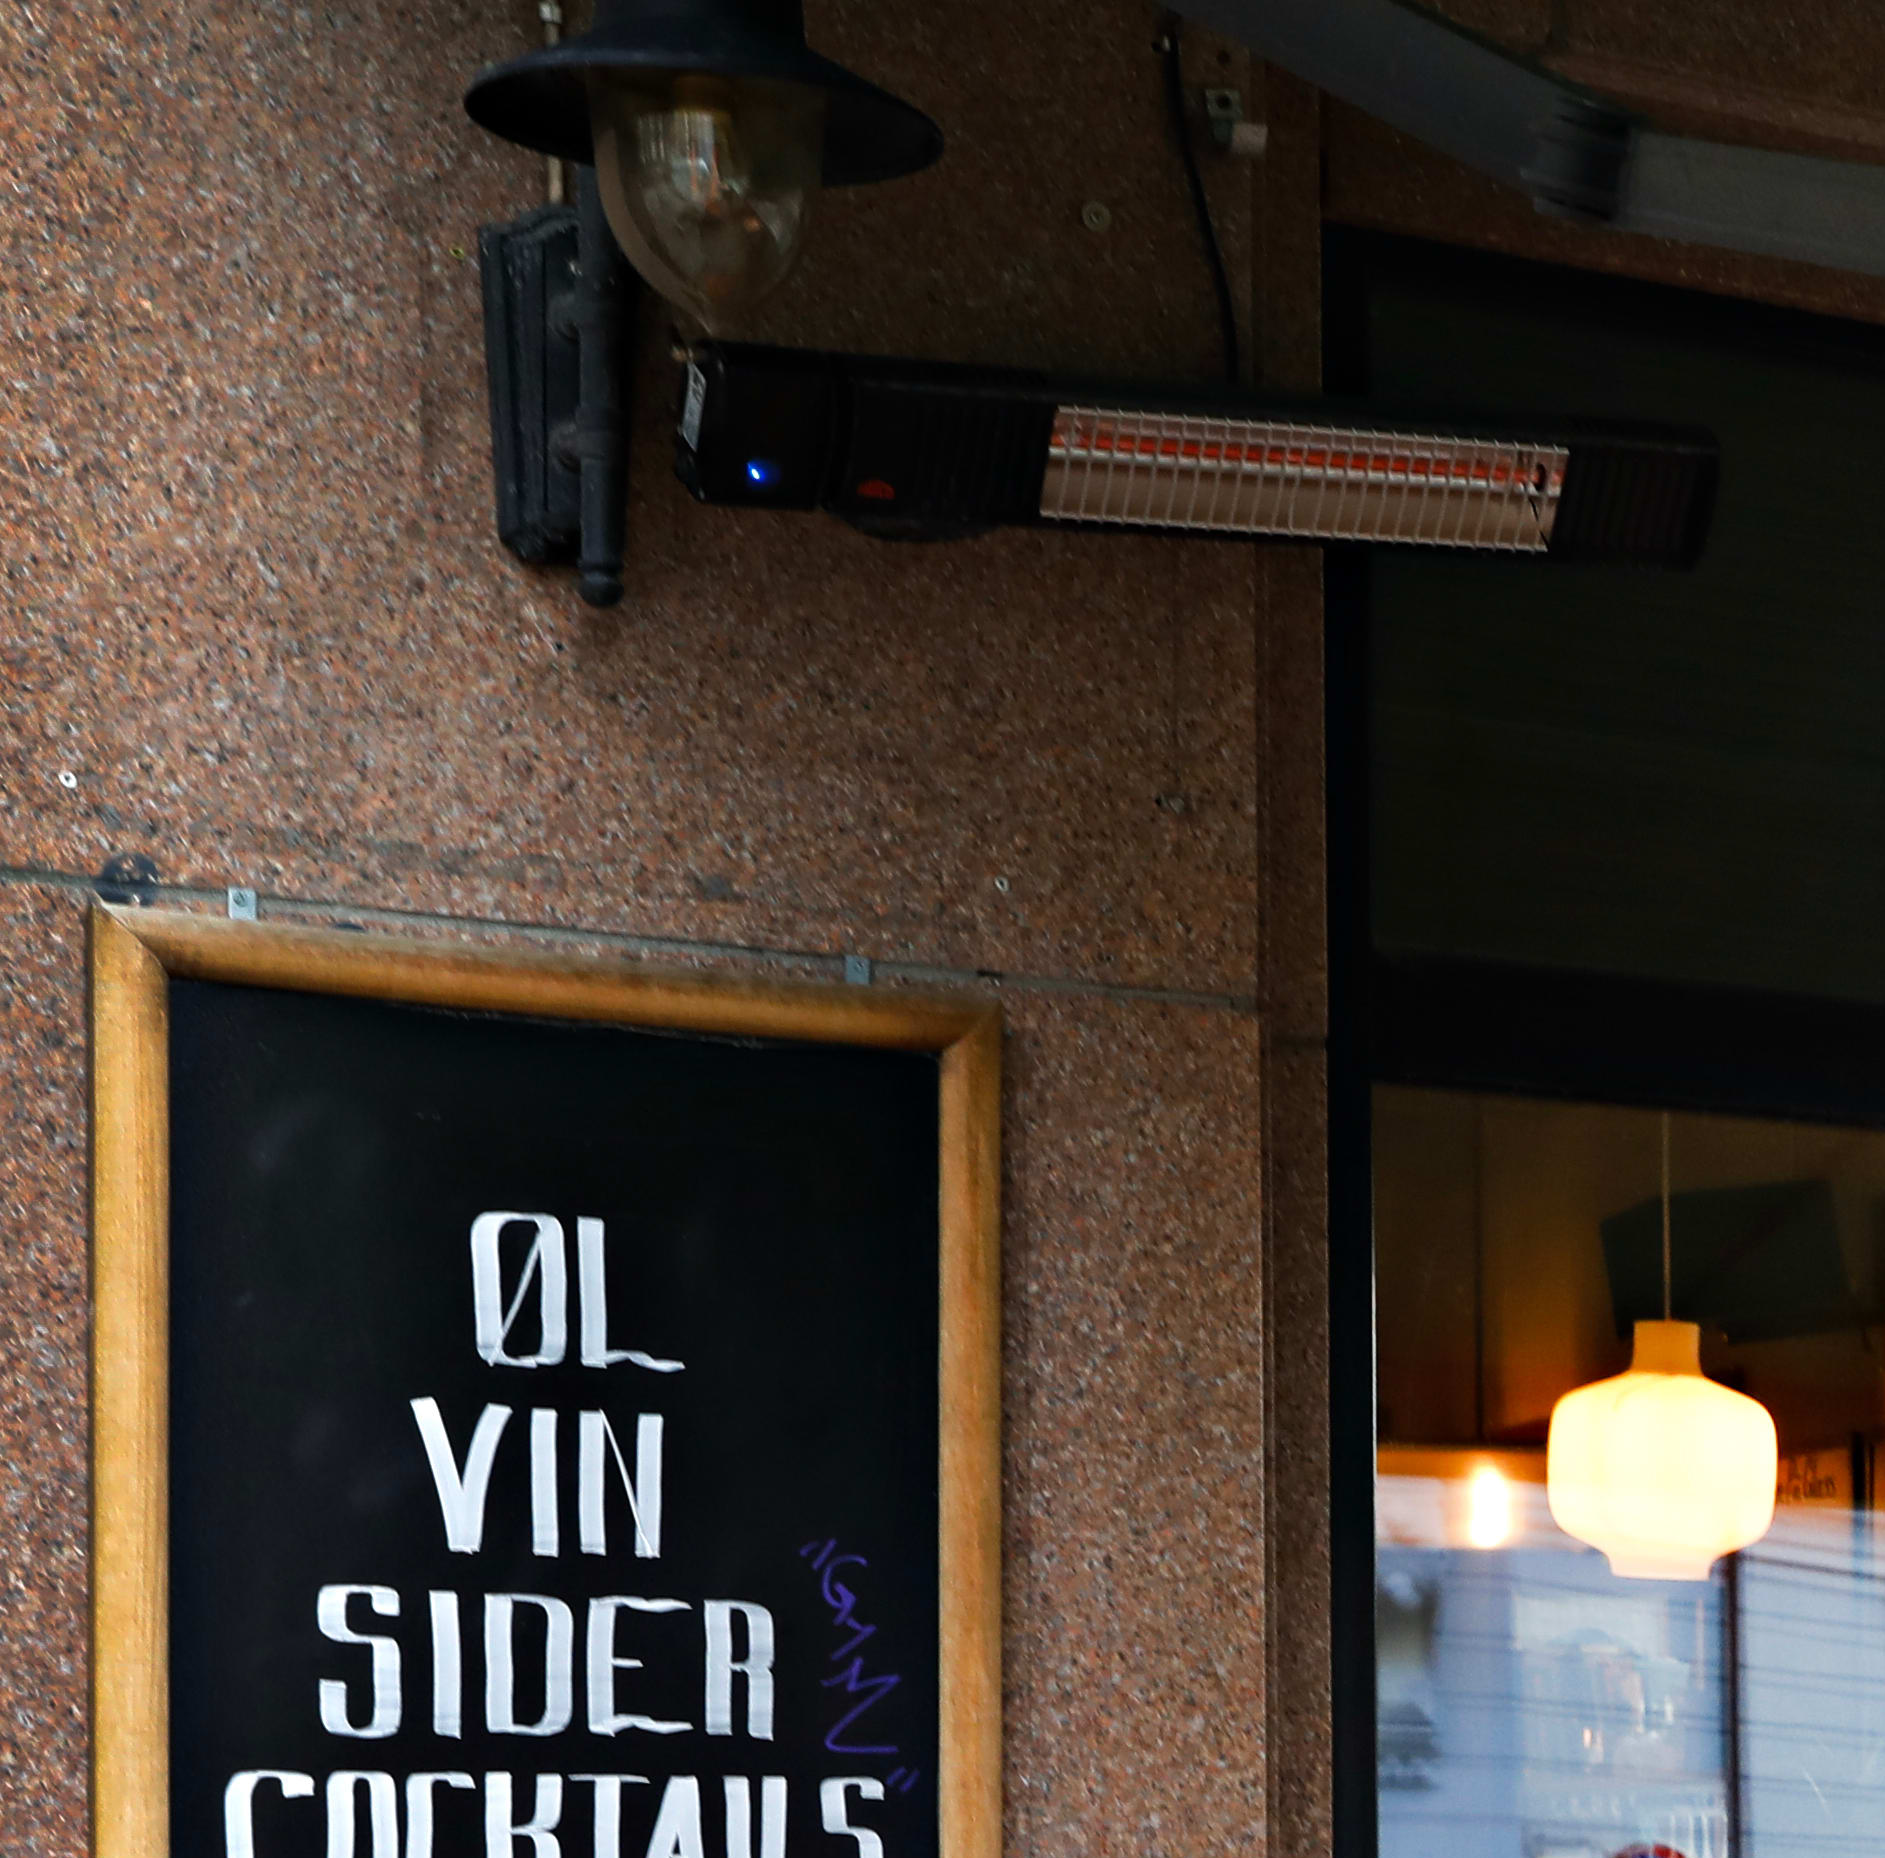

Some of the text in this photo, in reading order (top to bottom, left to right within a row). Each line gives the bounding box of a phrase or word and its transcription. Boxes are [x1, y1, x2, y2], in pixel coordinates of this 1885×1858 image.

[470, 1211, 686, 1370] ØL
[409, 1396, 664, 1560] VIN
[316, 1584, 776, 1741] SIDER
